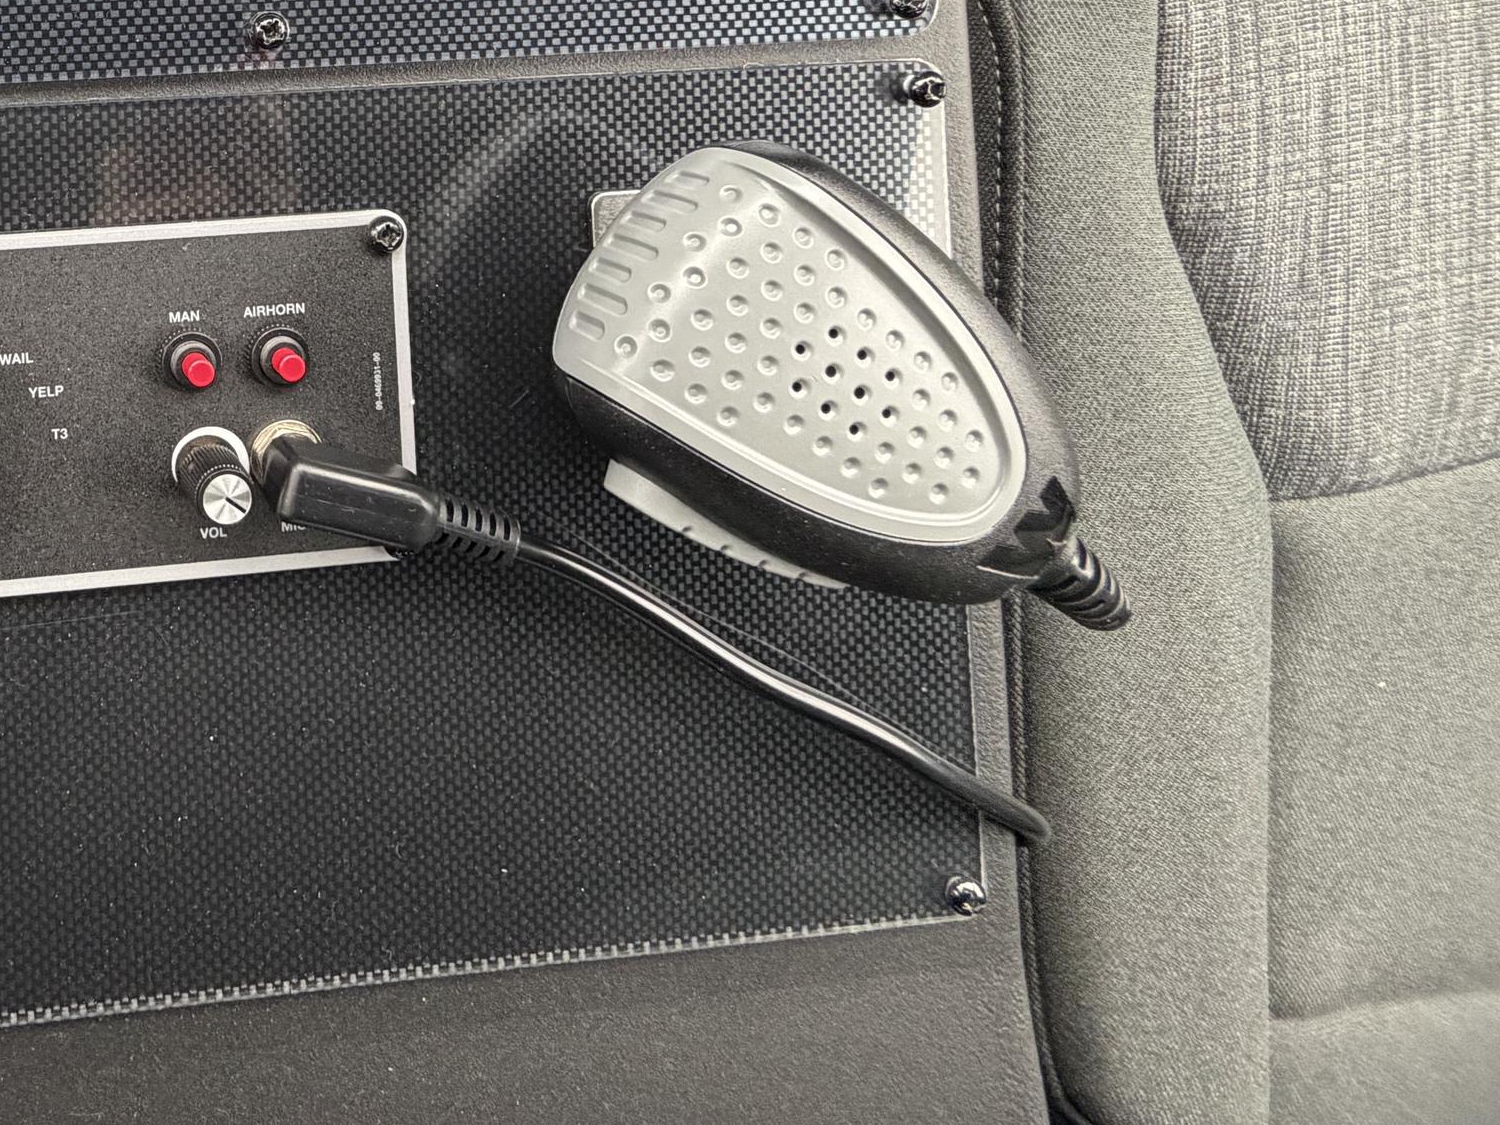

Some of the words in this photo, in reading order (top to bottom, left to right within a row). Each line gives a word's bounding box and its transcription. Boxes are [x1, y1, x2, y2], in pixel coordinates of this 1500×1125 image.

[168, 310, 201, 324] MAN
[243, 302, 306, 319] AIRHORN
[28, 385, 65, 399] YELP
[51, 428, 69, 441] T3
[199, 526, 228, 539] VOL
